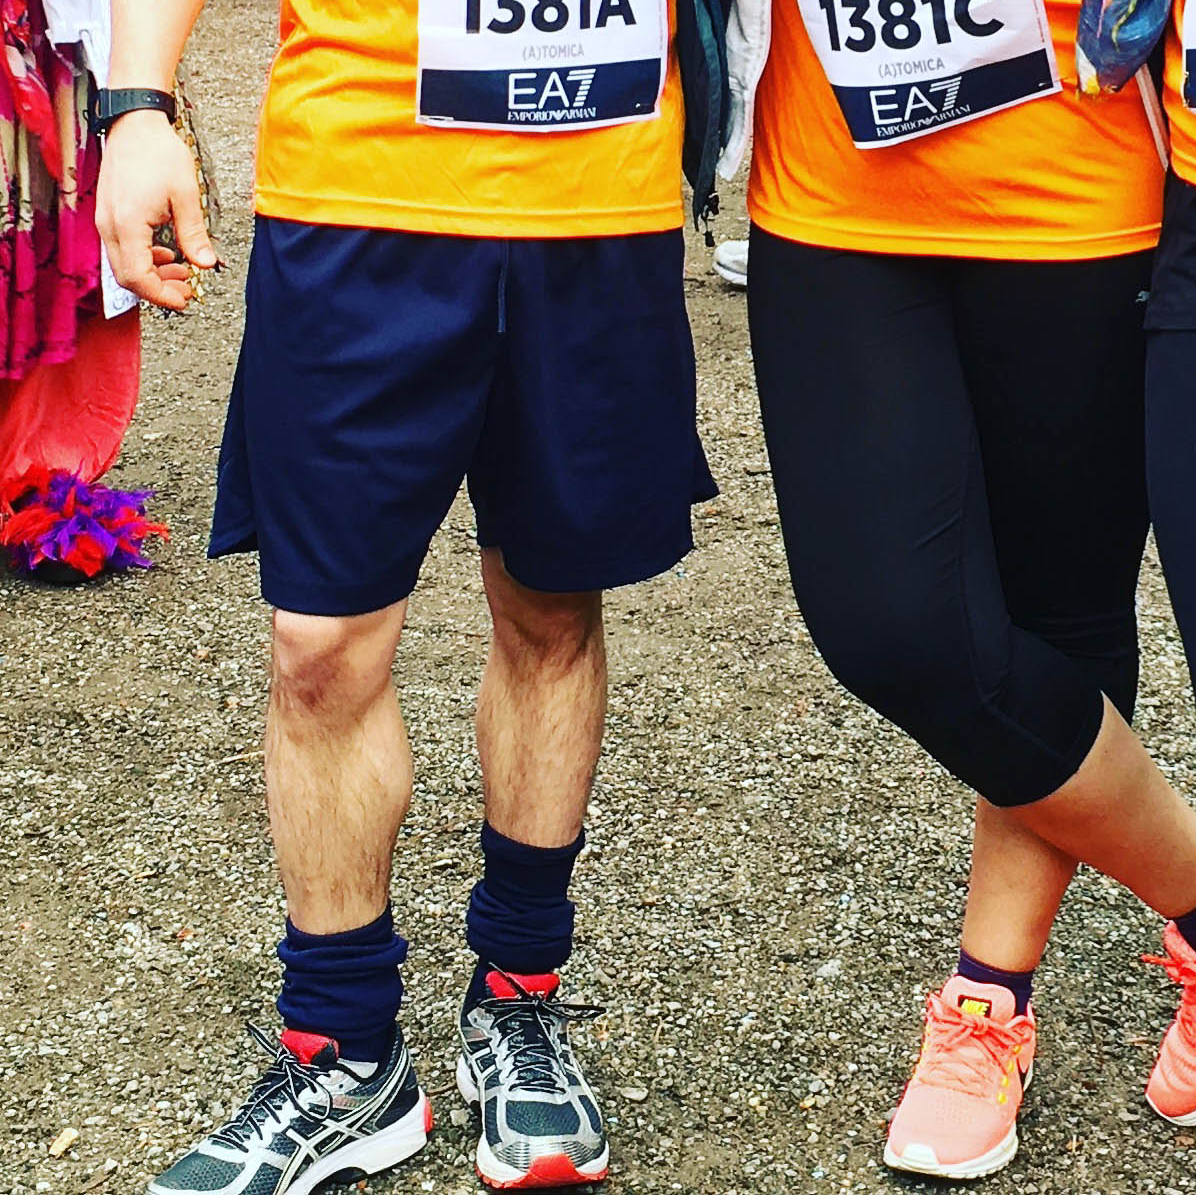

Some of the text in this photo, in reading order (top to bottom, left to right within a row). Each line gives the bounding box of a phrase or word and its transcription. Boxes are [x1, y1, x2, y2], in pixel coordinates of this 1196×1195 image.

[522, 43, 585, 61] (A)TOMICA
[878, 57, 945, 78] (A)TOMICA
[508, 68, 597, 110] EA7
[869, 76, 963, 125] EA7
[507, 109, 553, 122] EMPORIO
